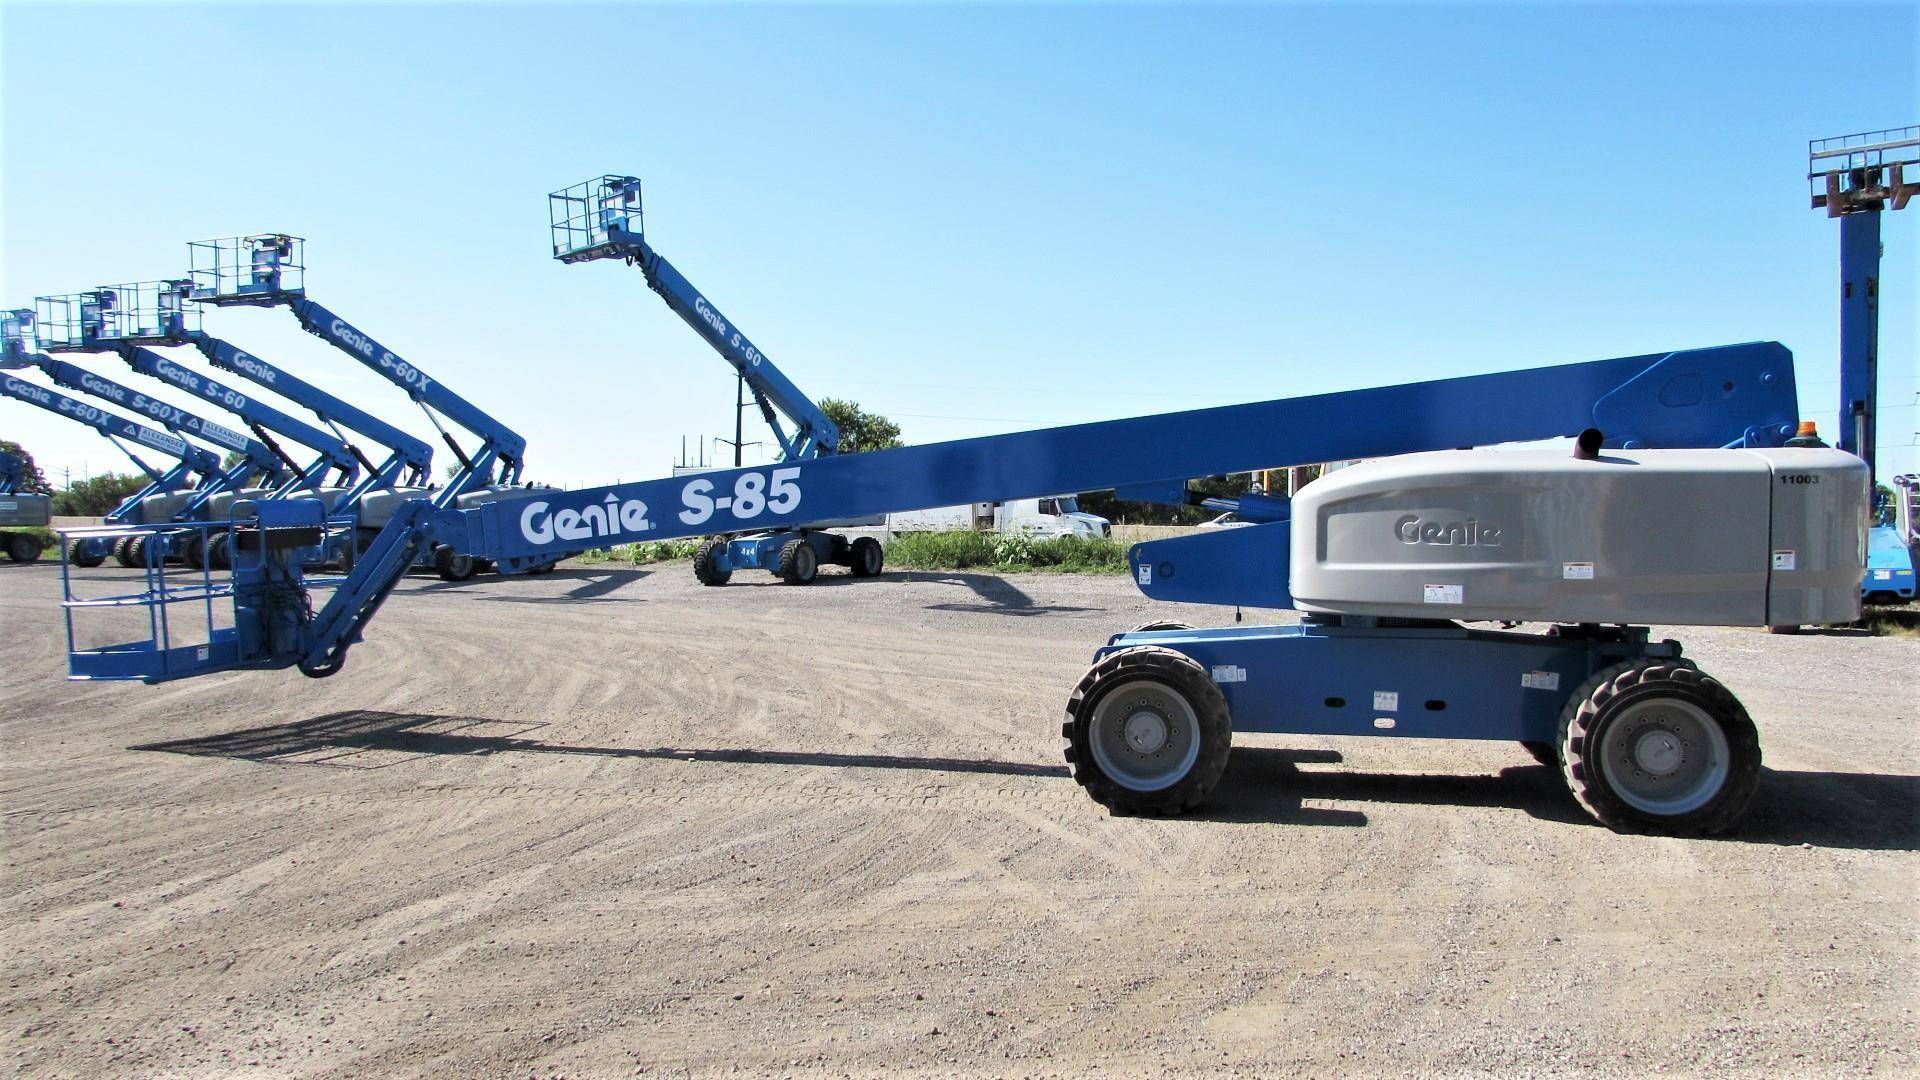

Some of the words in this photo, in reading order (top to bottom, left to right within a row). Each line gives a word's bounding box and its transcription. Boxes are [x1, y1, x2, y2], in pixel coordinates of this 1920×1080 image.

[331, 319, 374, 358] Genie
[695, 297, 726, 336] Genie
[731, 333, 762, 367] S-60
[233, 351, 276, 384] Genie
[6, 377, 50, 404] Genie
[81, 374, 125, 401] Genie
[156, 359, 199, 390] Genie
[205, 382, 246, 410] S-60
[206, 422, 247, 446] ALEXANDER
[1781, 475, 1820, 485] 11003
[520, 492, 649, 546] Genie
[678, 467, 801, 526] S-85
[1395, 514, 1501, 546] Genie
